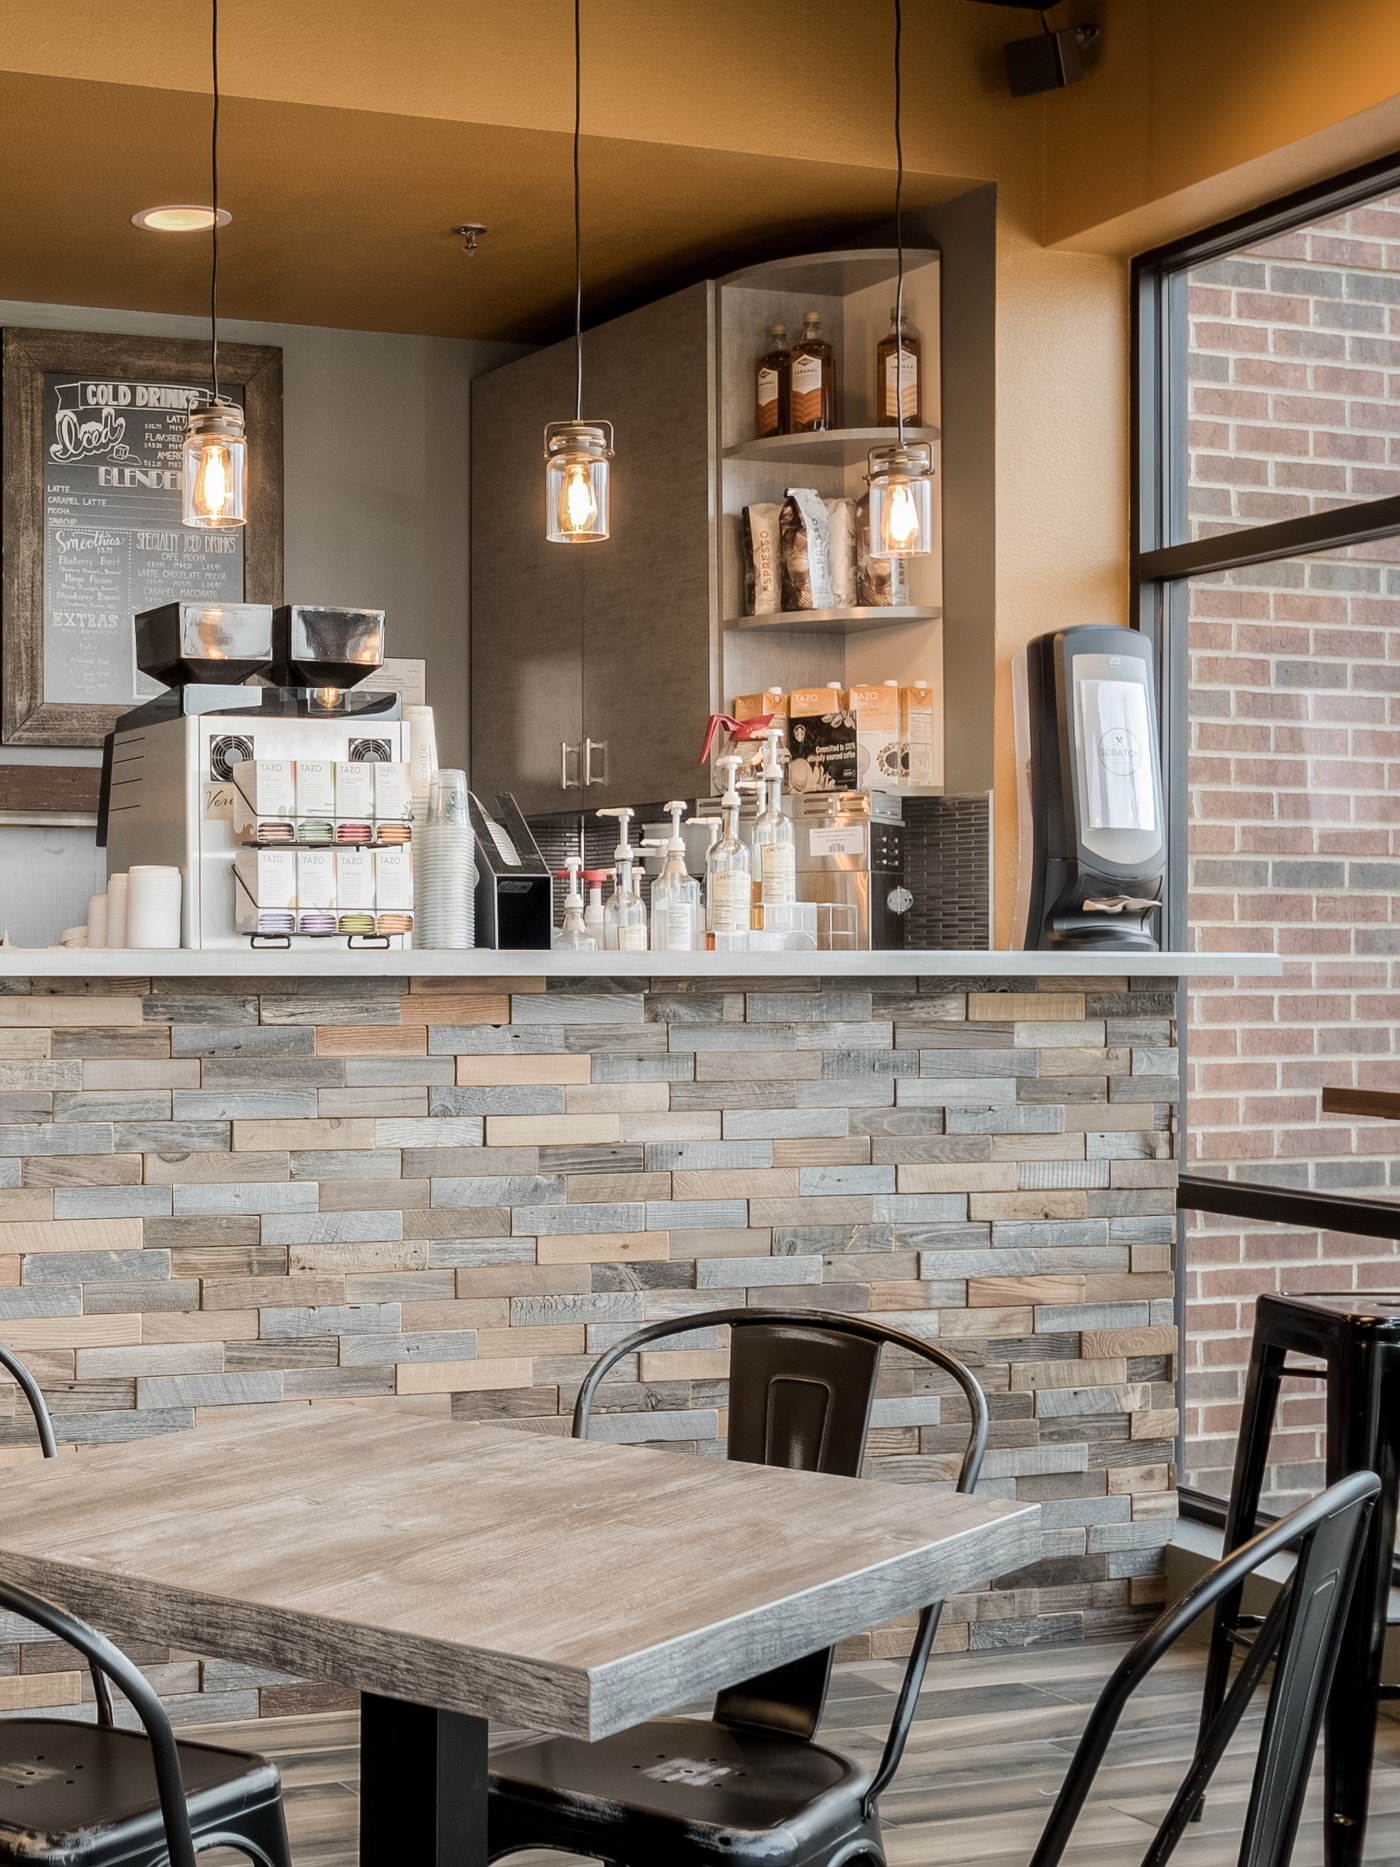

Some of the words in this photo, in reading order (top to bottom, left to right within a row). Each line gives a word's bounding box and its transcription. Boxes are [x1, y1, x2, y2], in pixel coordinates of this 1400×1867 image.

[86, 384, 132, 406] COLD
[135, 386, 200, 410] DRINKS
[166, 415, 187, 424] LATT
[50, 408, 126, 463] Iced
[144, 432, 183, 442] FLAVORED
[47, 485, 70, 493] LATTE
[47, 496, 79, 505] CARAMEL
[82, 498, 107, 507] LATTE
[47, 507, 71, 515] MOCHA
[55, 530, 125, 554] Smoothies
[136, 532, 180, 552] SPECIALTY
[184, 534, 202, 553] ICED
[204, 535, 236, 554] DRINKS
[160, 552, 179, 561] CAFE
[182, 553, 206, 562] MOCHA
[760, 530, 772, 592] ESPRESSO
[162, 569, 201, 580] CHOCOLATE
[204, 571, 227, 581] MOCHA
[52, 611, 119, 629] EXTRAS
[794, 693, 819, 703] TAZO
[853, 691, 877, 701] TAZO
[261, 764, 282, 773] TAZO
[300, 765, 322, 773] TAZO
[339, 766, 361, 774] TAZO
[262, 855, 284, 863] TAZO
[303, 856, 325, 865] TAZO
[341, 857, 363, 865] TAZO
[379, 856, 401, 864] TAZO
